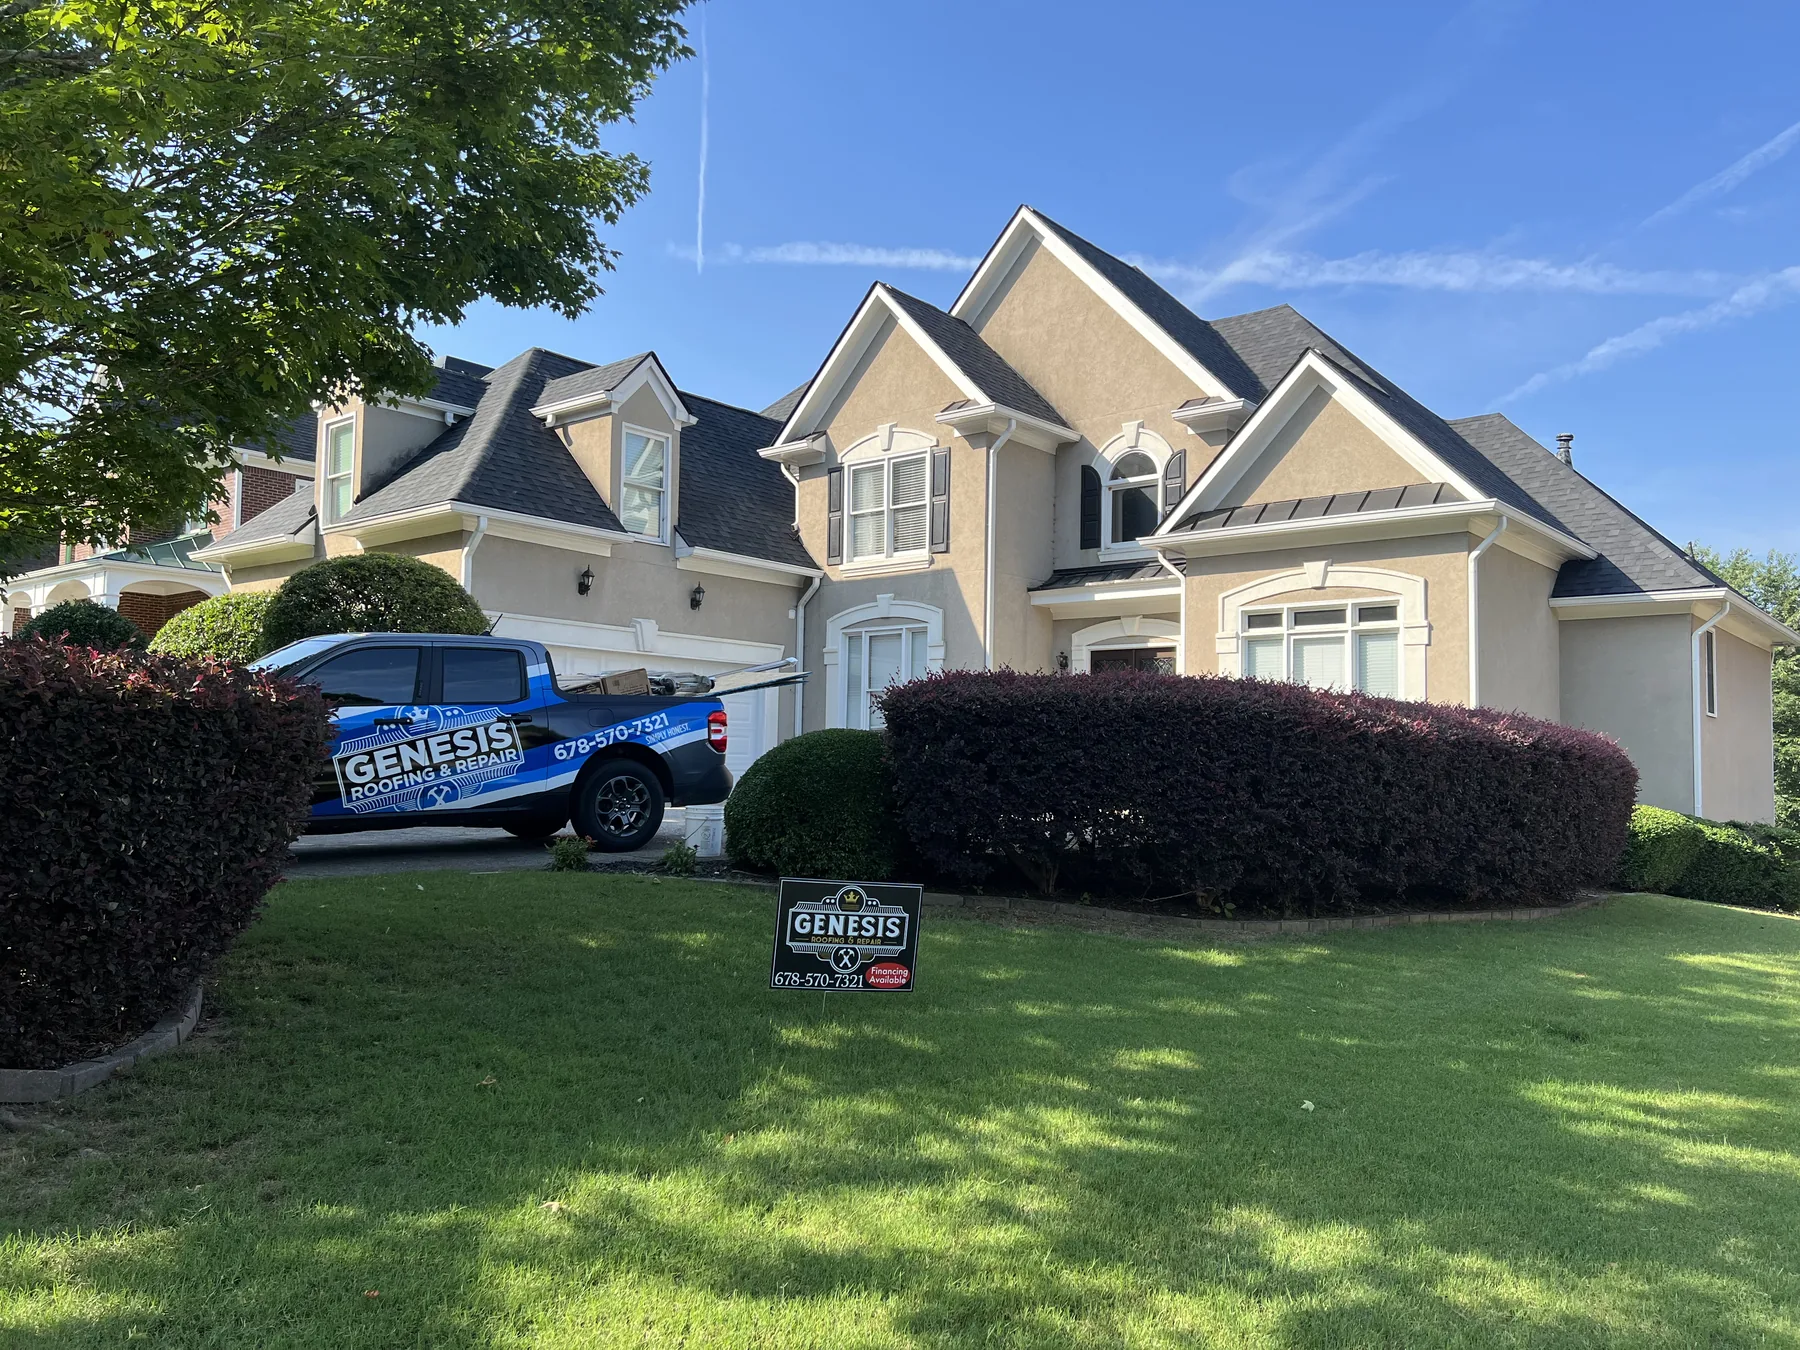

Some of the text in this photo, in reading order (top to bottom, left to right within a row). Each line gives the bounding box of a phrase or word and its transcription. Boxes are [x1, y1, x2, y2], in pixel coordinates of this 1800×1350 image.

[554, 712, 669, 760] 678-570-7321
[645, 730, 667, 745] SIMPLY
[345, 722, 513, 784] GENESIS
[351, 748, 519, 800] ROOFING & REPAIR
[794, 913, 901, 938] GENESIS
[811, 936, 845, 944] ROOFING
[774, 972, 864, 988] 678-570-7321
[869, 976, 907, 984] Available
[871, 967, 909, 977] Financing
